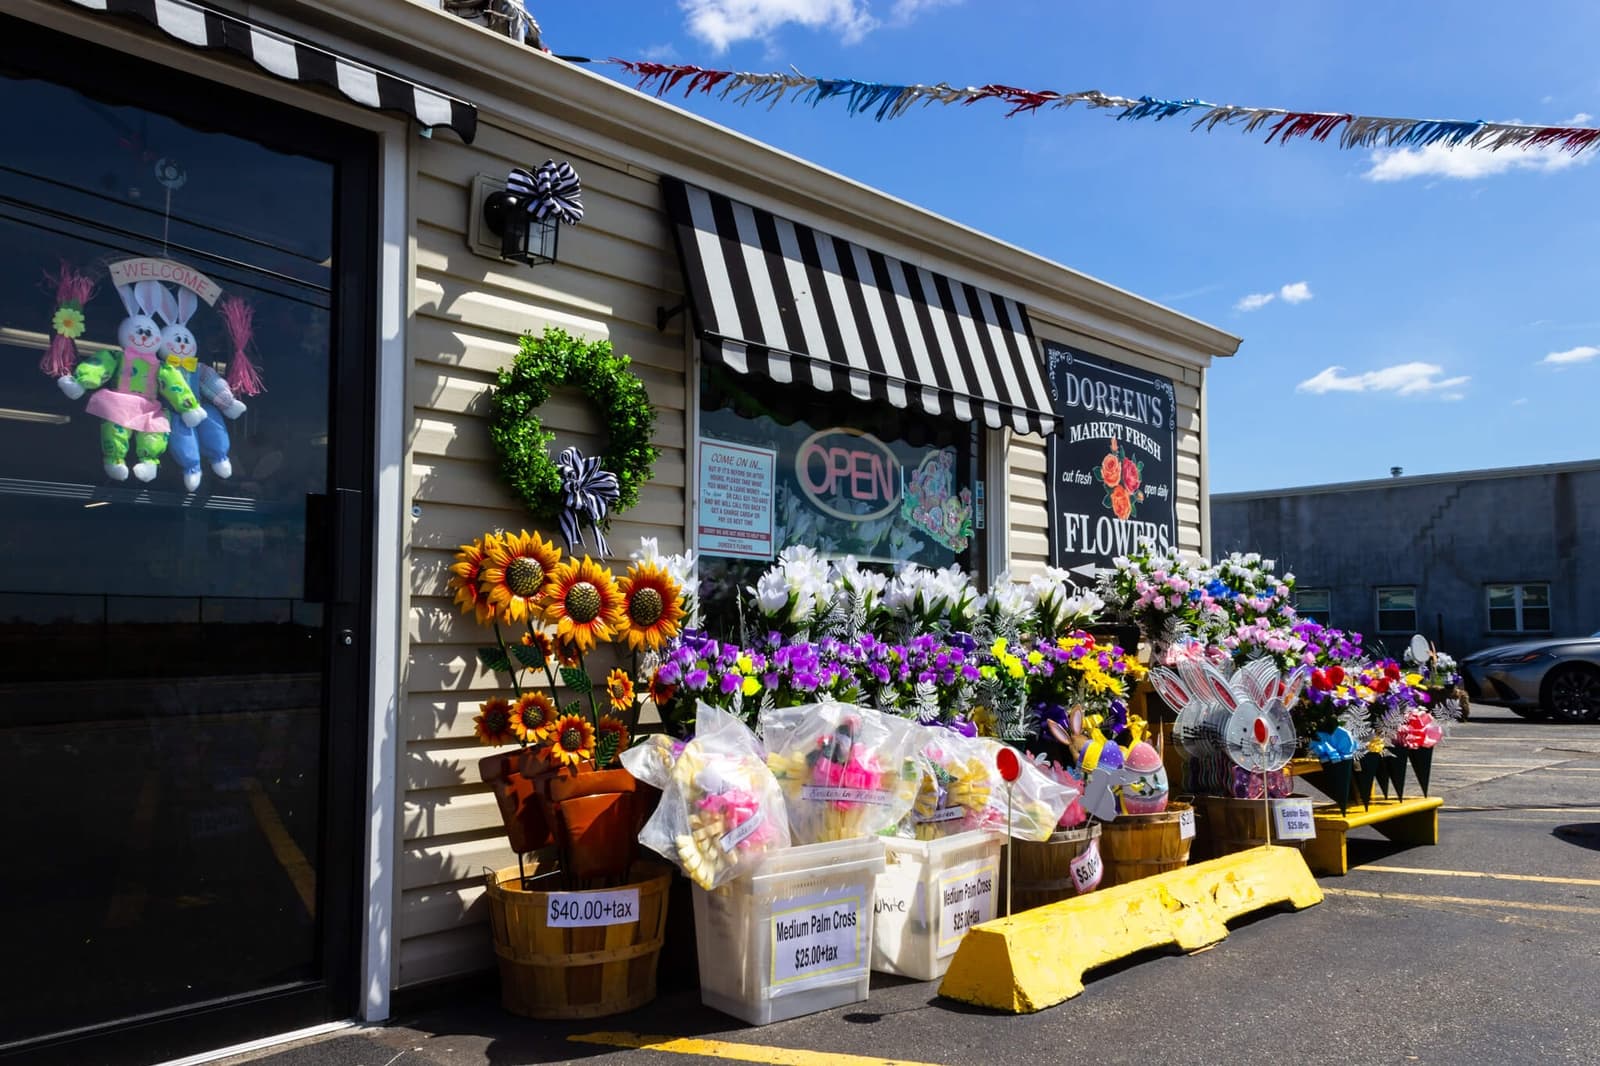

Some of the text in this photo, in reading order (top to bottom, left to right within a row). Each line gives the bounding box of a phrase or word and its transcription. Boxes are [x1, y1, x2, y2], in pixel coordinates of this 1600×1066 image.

[123, 262, 208, 295] WELCOME
[1065, 372, 1163, 428] DOREEN'S
[1070, 422, 1162, 462] MARKET FRESH
[712, 452, 734, 465] COME
[736, 457, 748, 468] ON
[802, 444, 893, 501] OPEN
[1062, 470, 1092, 485] cut fresh
[1144, 484, 1169, 501] open daily
[1064, 512, 1169, 560] FLOWERS
[977, 878, 991, 895] Cross
[550, 898, 632, 922] $40.00+tax
[776, 910, 856, 942] Medium Palm Cross
[795, 944, 838, 971] $25.00+tax
